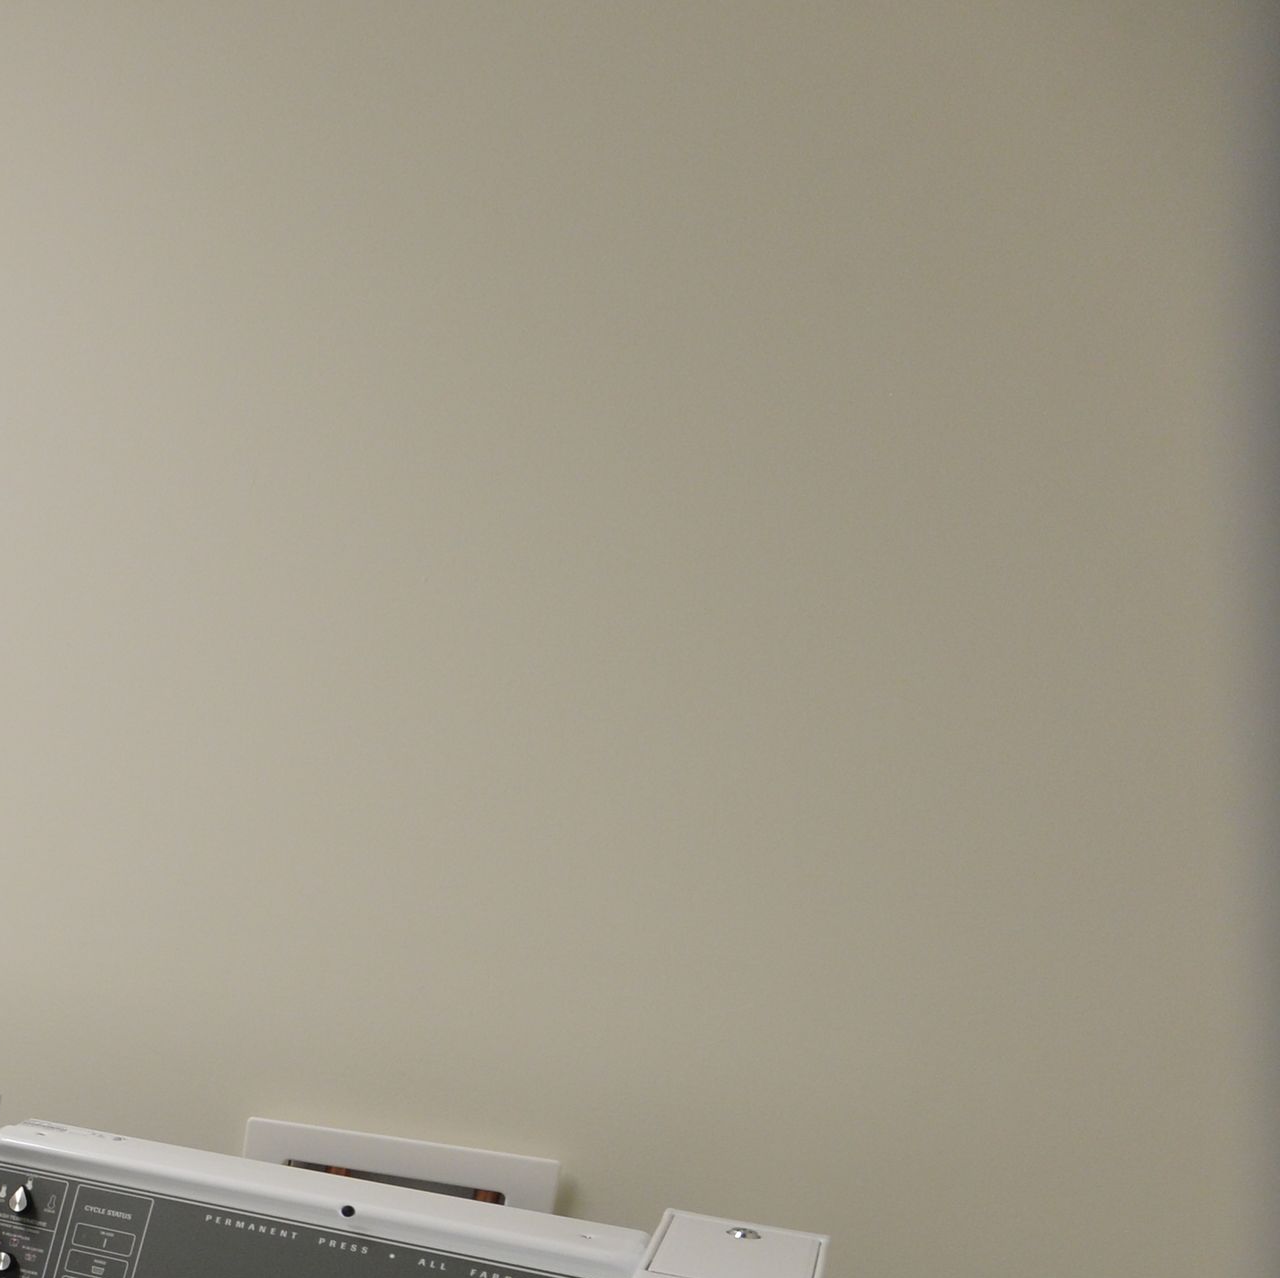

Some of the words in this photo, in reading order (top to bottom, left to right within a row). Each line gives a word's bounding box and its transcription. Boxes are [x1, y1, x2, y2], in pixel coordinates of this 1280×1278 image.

[84, 1204, 107, 1215] CYCLE
[106, 1209, 132, 1221] STATUS
[205, 1213, 299, 1240] PERMANENT
[318, 1236, 370, 1255] PRESS
[417, 1258, 447, 1272] ALL
